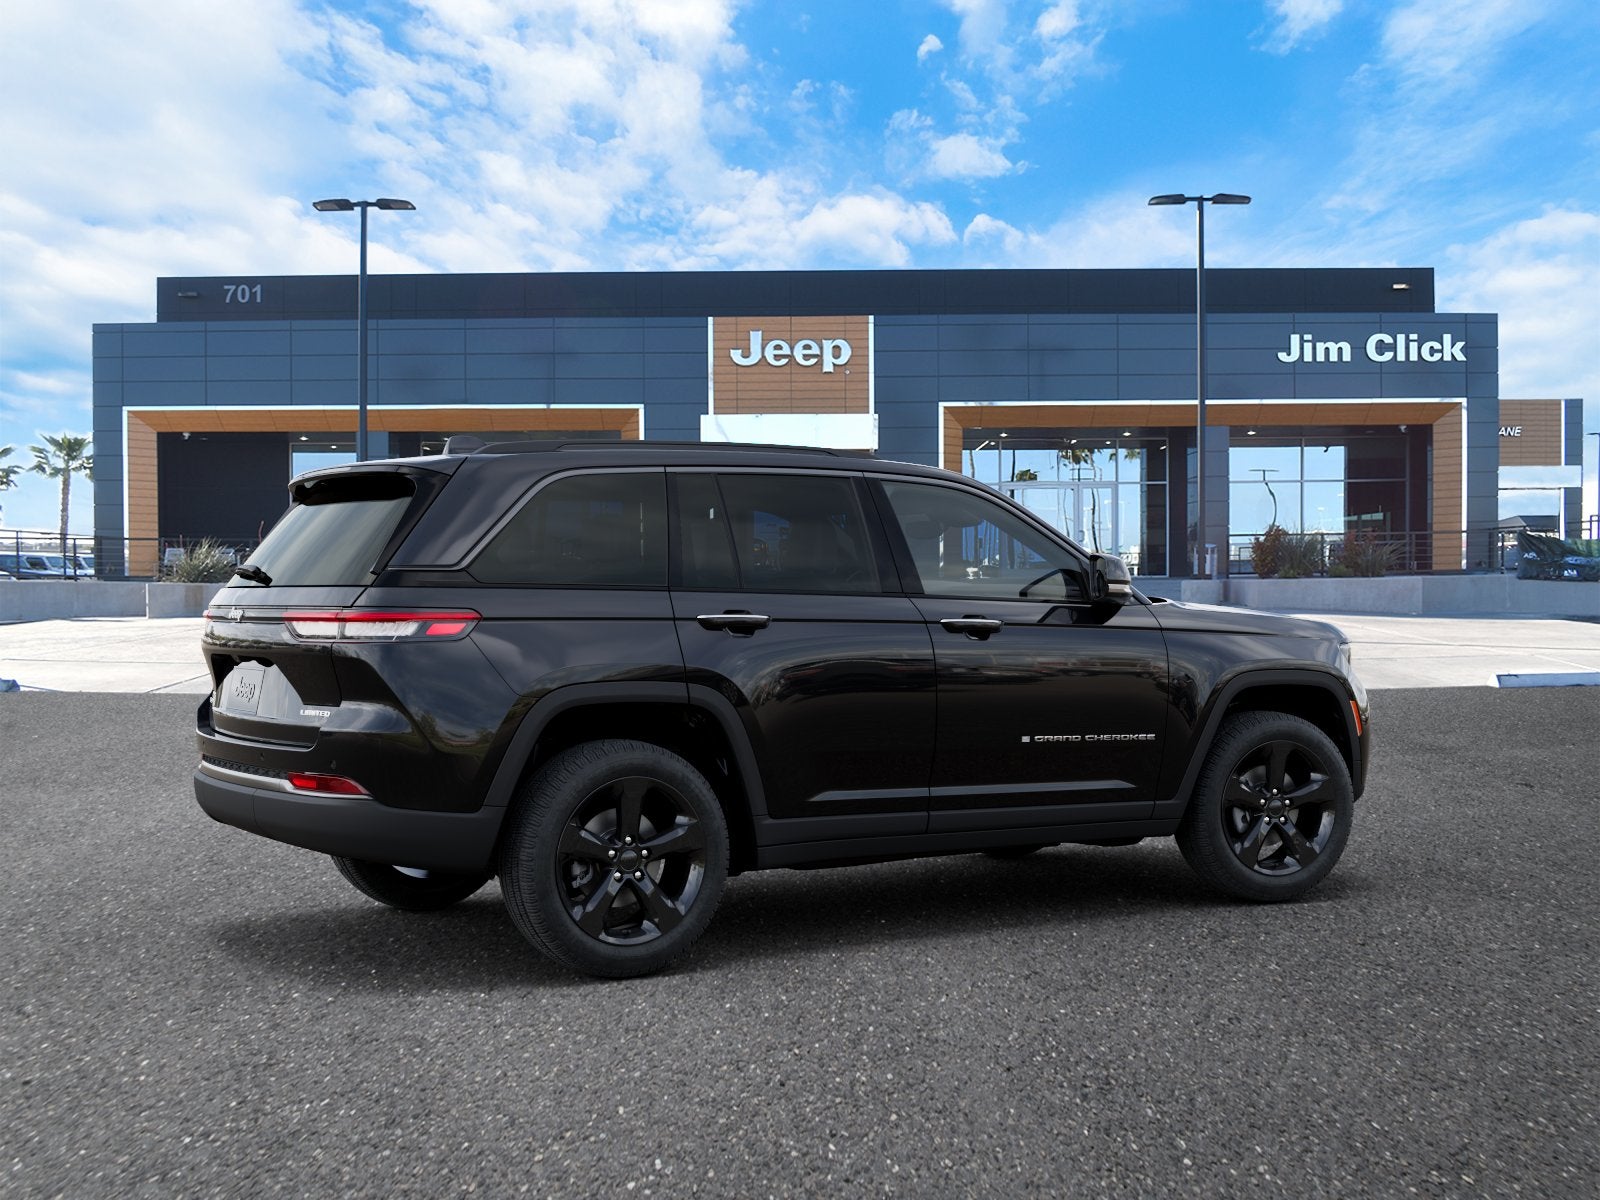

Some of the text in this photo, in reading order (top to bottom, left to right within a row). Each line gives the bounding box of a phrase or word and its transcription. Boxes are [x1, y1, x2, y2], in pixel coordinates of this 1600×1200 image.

[223, 284, 262, 303] 701
[729, 330, 852, 373] Jeep
[1277, 333, 1467, 363] Jim Click
[300, 709, 331, 718] LIMITED
